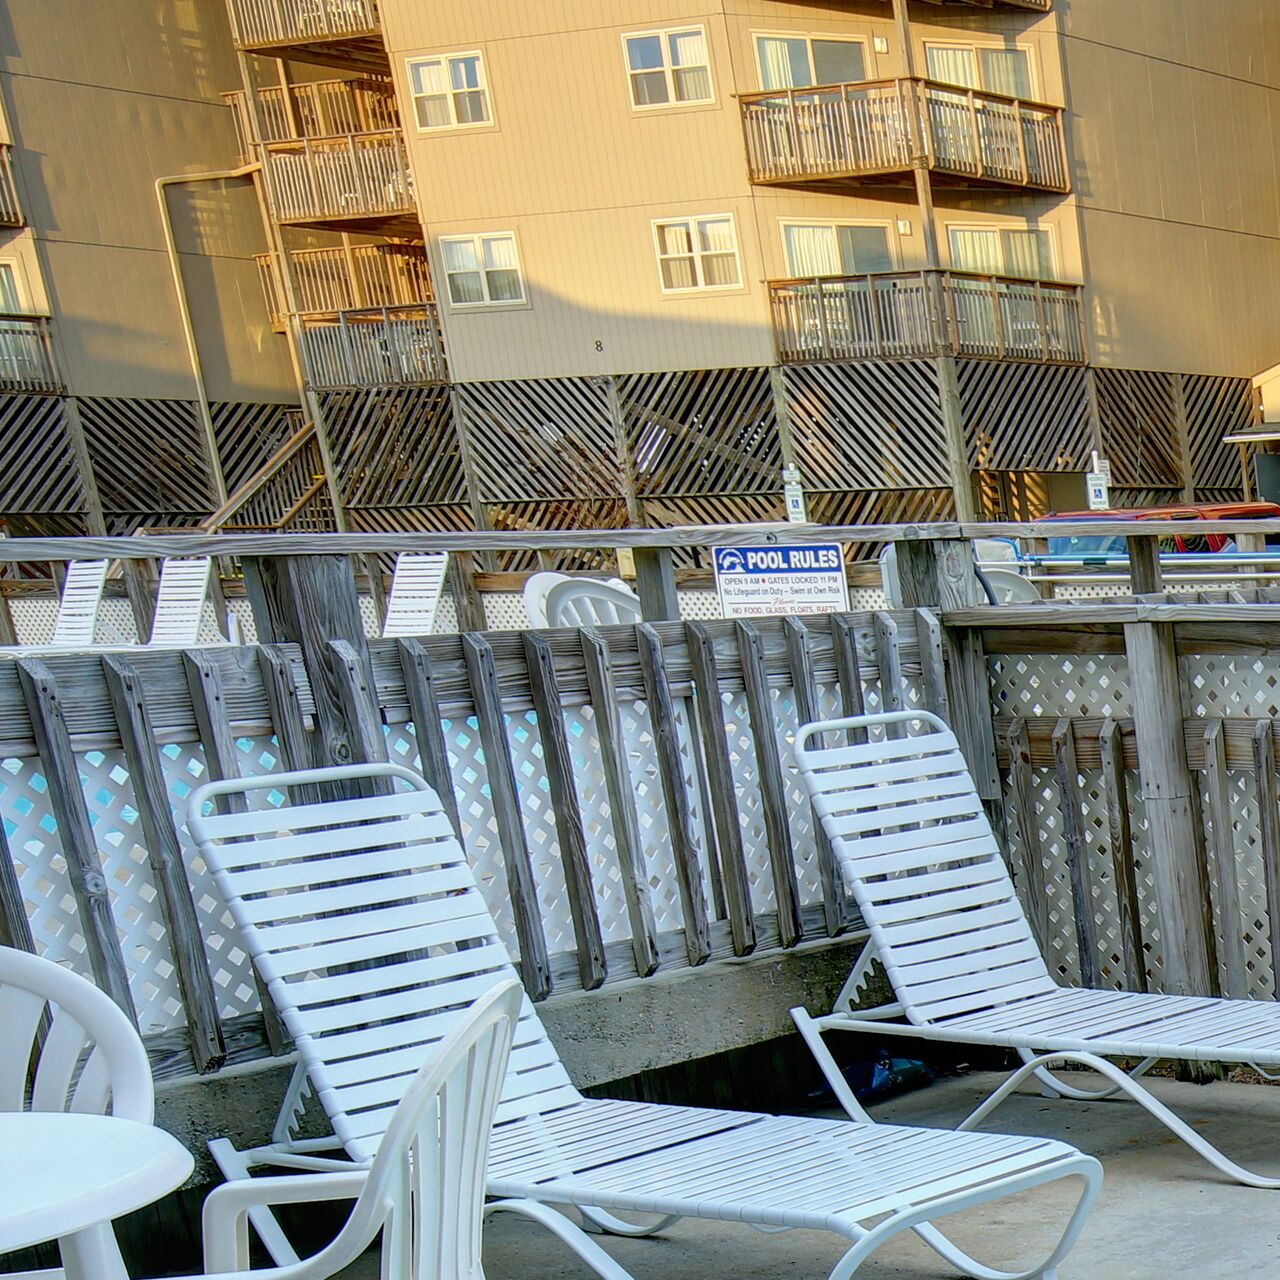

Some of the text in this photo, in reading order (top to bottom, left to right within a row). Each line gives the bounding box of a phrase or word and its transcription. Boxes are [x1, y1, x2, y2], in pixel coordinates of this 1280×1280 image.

[595, 340, 603, 352] 8
[747, 549, 839, 569] POOL RULES
[768, 576, 790, 584] GATES
[791, 576, 818, 584] LOCKED
[734, 588, 760, 597] Lifeguard
[770, 587, 783, 596] Duty
